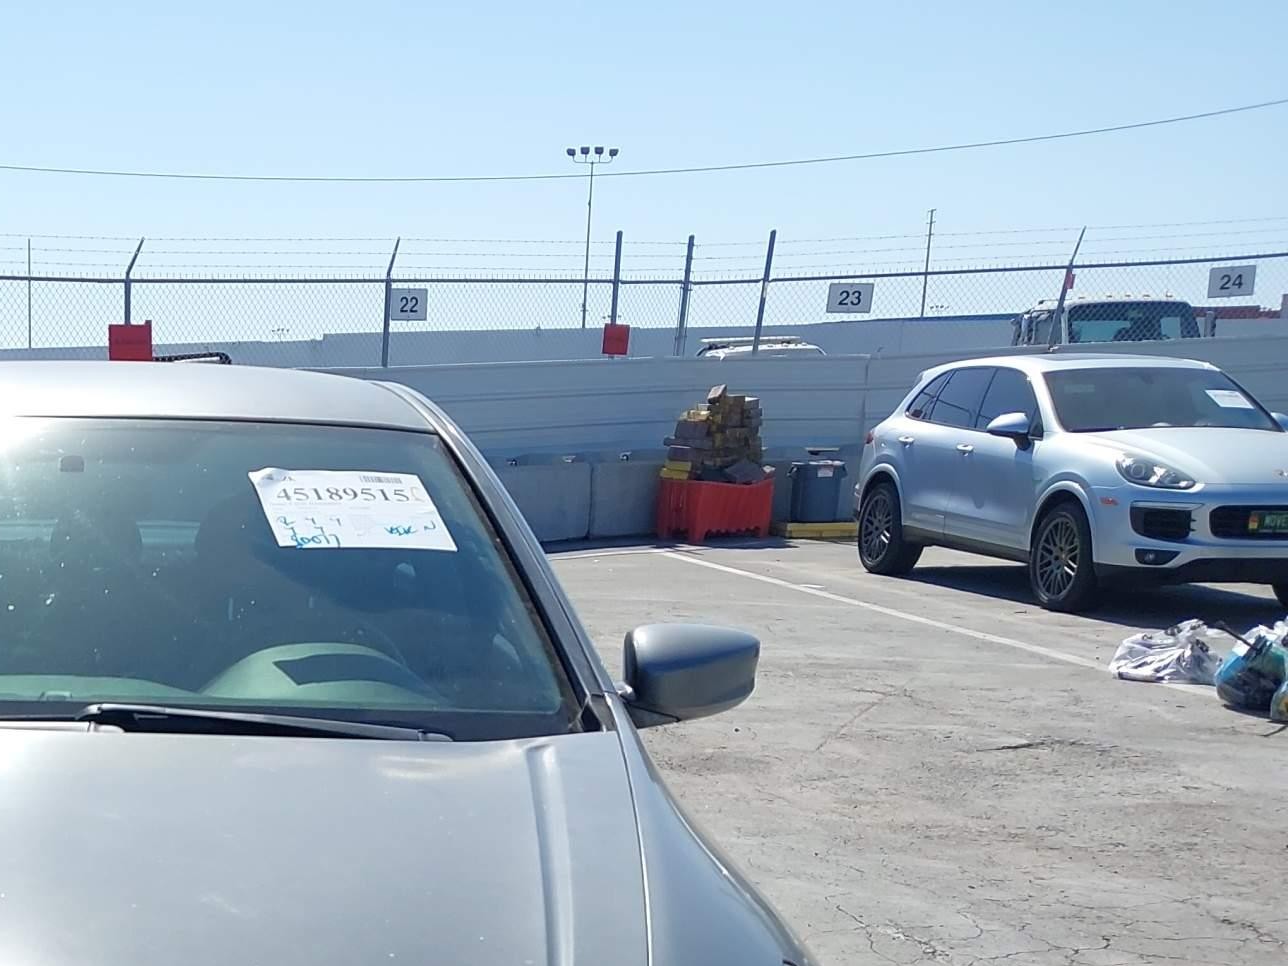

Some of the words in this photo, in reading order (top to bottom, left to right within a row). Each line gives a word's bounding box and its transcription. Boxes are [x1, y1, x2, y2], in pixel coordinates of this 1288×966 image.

[1219, 274, 1244, 290] 24
[399, 296, 419, 313] 22
[838, 290, 862, 306] 23
[276, 486, 411, 502] 45189515
